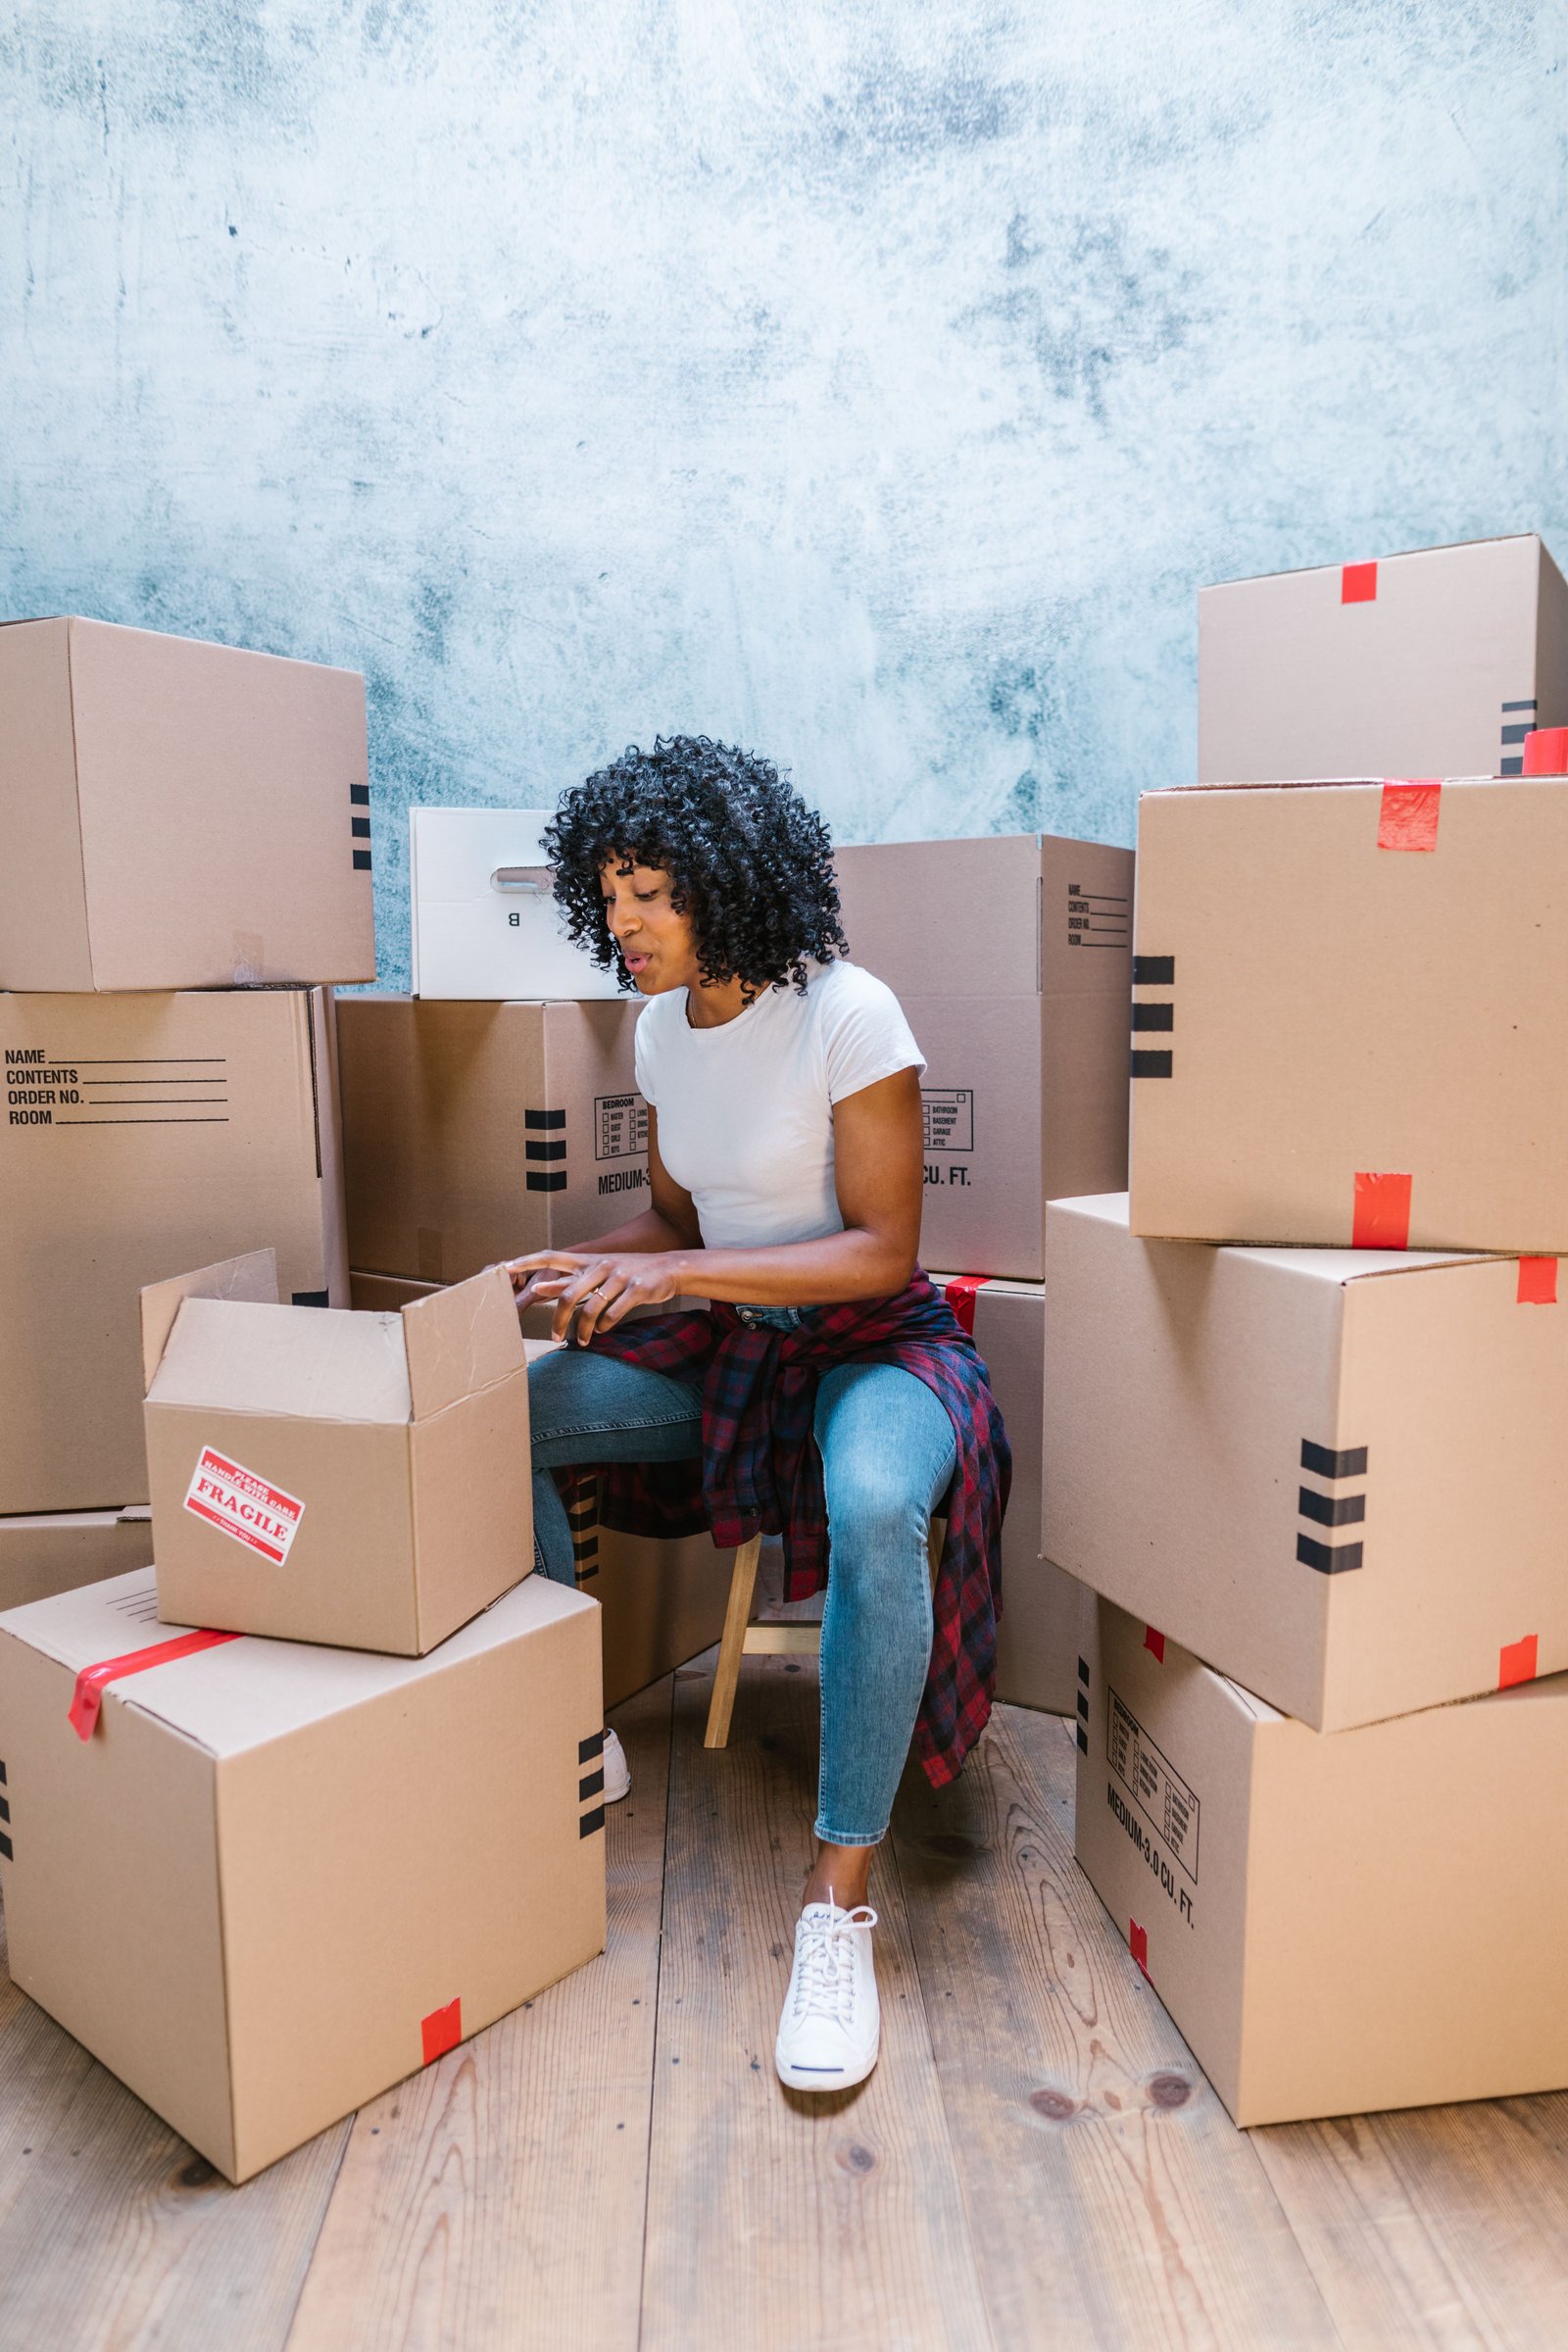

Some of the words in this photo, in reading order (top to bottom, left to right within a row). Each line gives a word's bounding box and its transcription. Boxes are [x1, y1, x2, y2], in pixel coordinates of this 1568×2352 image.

[5, 1050, 46, 1064] NAME
[6, 1069, 78, 1085] CONTENTS
[8, 1090, 56, 1104] ORDER
[59, 1090, 84, 1104] NO.
[602, 1098, 634, 1109] BEDROOM
[9, 1110, 52, 1125] ROOM
[932, 1138, 946, 1147] ATTIC
[949, 1166, 971, 1186] FT.
[204, 1459, 244, 1488] HANDLE
[243, 1482, 270, 1506] WITH
[269, 1498, 297, 1520] CARE
[234, 1470, 270, 1494] PLEASE
[196, 1476, 289, 1542] FRAGILE
[1113, 1696, 1139, 1739] BEDROOM
[1107, 1782, 1159, 1877] MEDIUM-3.0
[1160, 1861, 1177, 1905] CU.
[1180, 1887, 1195, 1931] FT.
